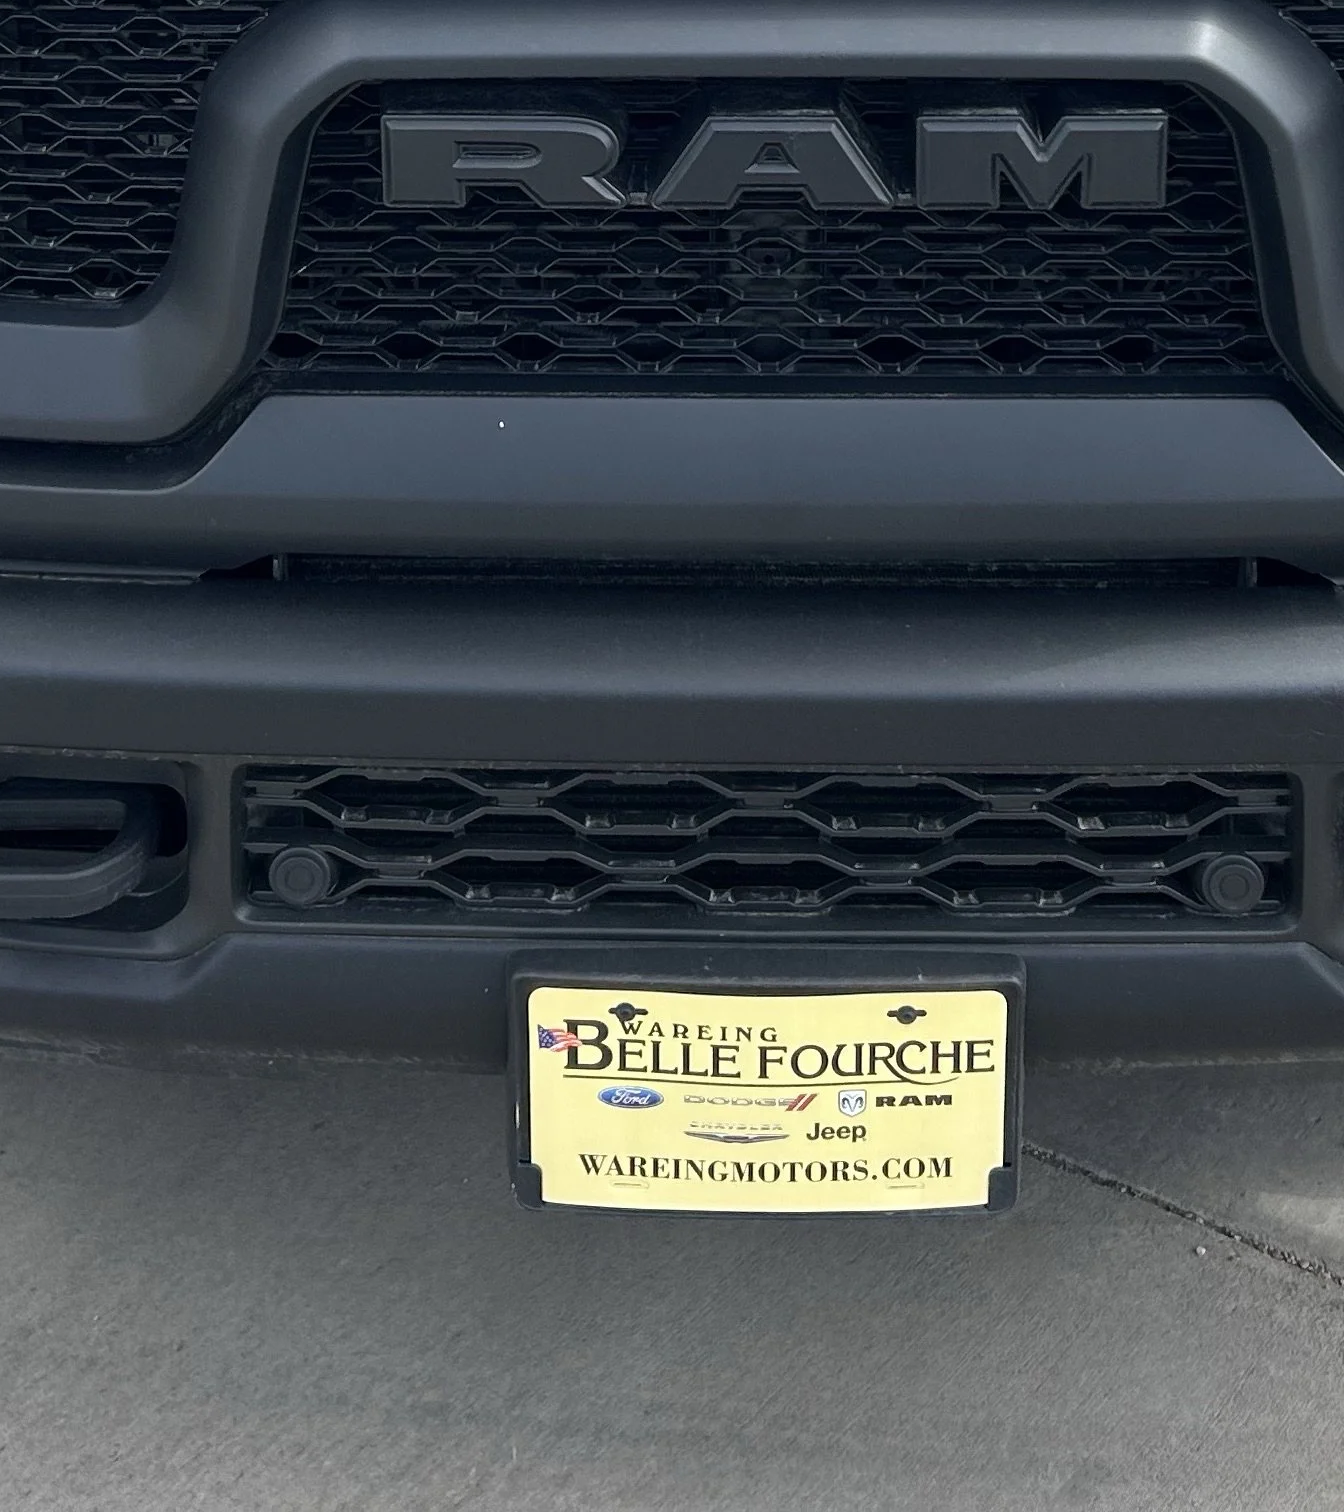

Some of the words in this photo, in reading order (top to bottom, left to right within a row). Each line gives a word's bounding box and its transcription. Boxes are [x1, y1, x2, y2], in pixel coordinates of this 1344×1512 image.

[382, 110, 1170, 210] RAM
[620, 1020, 778, 1043] WAREING
[563, 1019, 741, 1079] BELLE
[757, 1039, 996, 1082] FOURCHE
[610, 1087, 652, 1106] Ford
[683, 1094, 800, 1107] DODGE
[875, 1094, 953, 1108] RAM
[806, 1122, 867, 1143] Jeep
[577, 1152, 954, 1184] WAREINGMOTORS.COM
